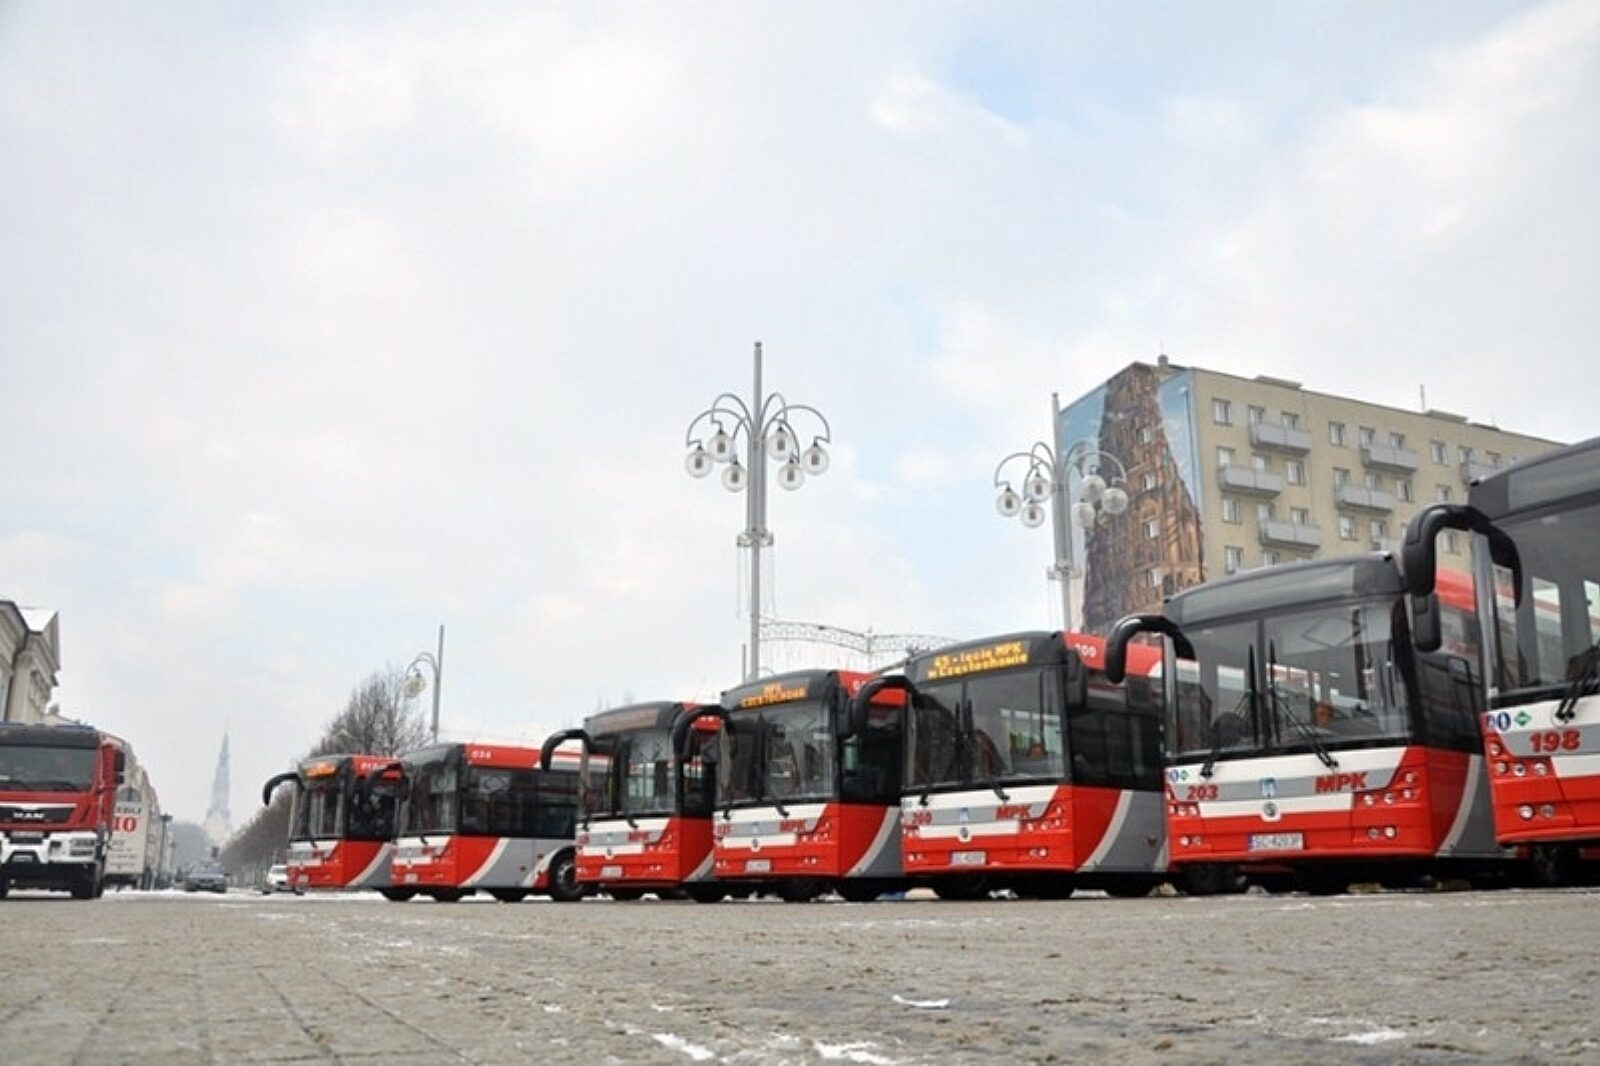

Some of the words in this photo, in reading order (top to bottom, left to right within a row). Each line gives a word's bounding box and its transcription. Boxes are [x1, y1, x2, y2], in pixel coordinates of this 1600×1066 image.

[1529, 728, 1580, 753] 198
[1187, 784, 1219, 801] 203
[1314, 771, 1368, 794] MPK
[996, 803, 1031, 821] MPK
